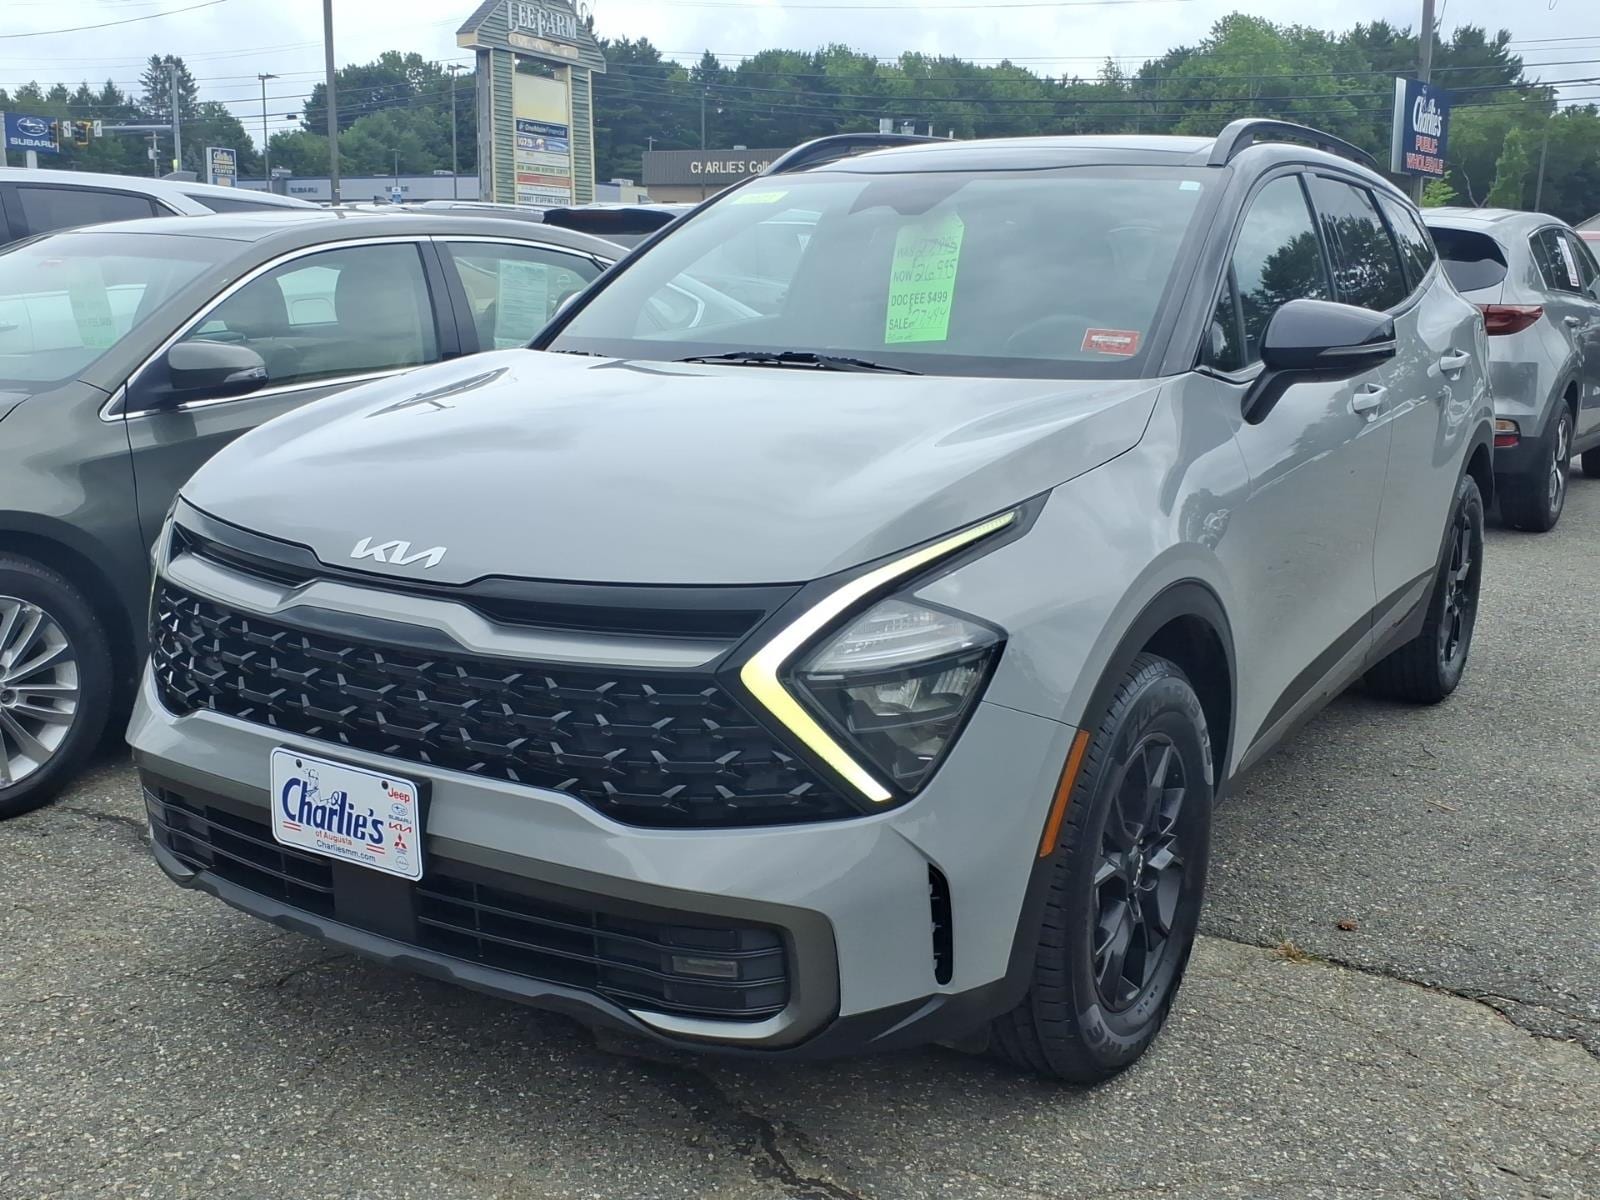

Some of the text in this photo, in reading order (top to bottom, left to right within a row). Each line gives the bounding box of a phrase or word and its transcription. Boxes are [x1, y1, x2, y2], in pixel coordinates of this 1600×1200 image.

[10, 137, 56, 148] SUBARU
[1415, 134, 1438, 155] PUBLIC
[690, 161, 745, 173] CHARLIE'S
[1406, 152, 1444, 174] WHOLESALE
[893, 270, 912, 282] NOW
[891, 290, 948, 307] DOC FEE $499
[888, 318, 909, 330] SALE
[282, 777, 410, 845] Charlie's Jeep
[388, 814, 412, 825] SUBARU
[315, 829, 353, 846] of Augusta
[316, 839, 376, 862] Charliesmm.com
